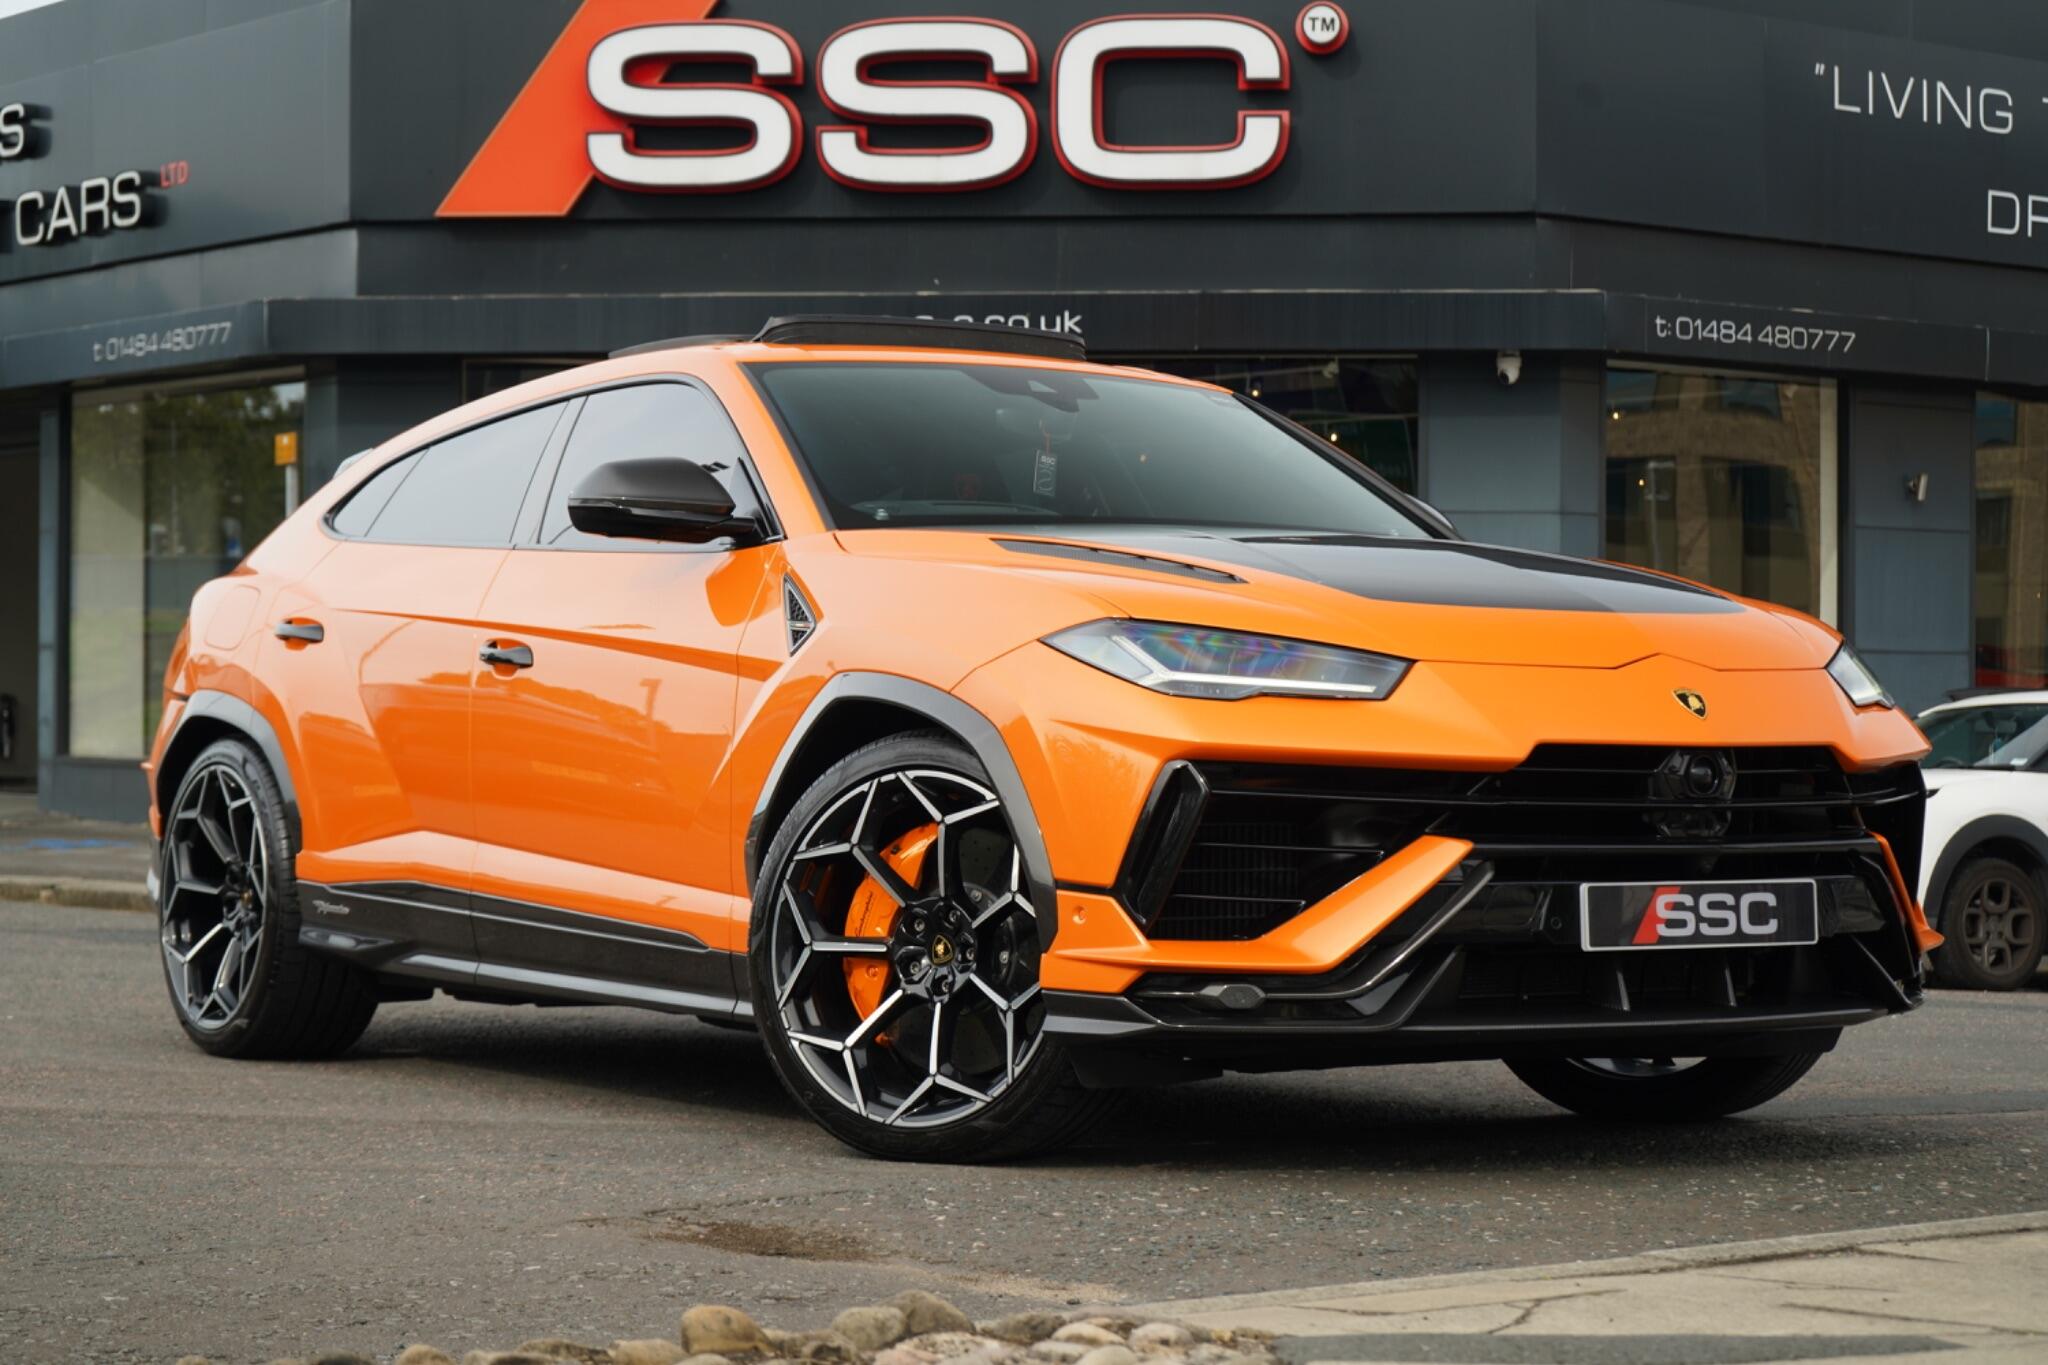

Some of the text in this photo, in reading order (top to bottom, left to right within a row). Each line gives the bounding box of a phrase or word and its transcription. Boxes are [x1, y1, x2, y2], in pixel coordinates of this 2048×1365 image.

[586, 14, 1335, 192] SSC TM
[15, 160, 190, 246] CARS LTD
[1757, 325, 1856, 353] 480777
[1655, 892, 1778, 938] SSC
